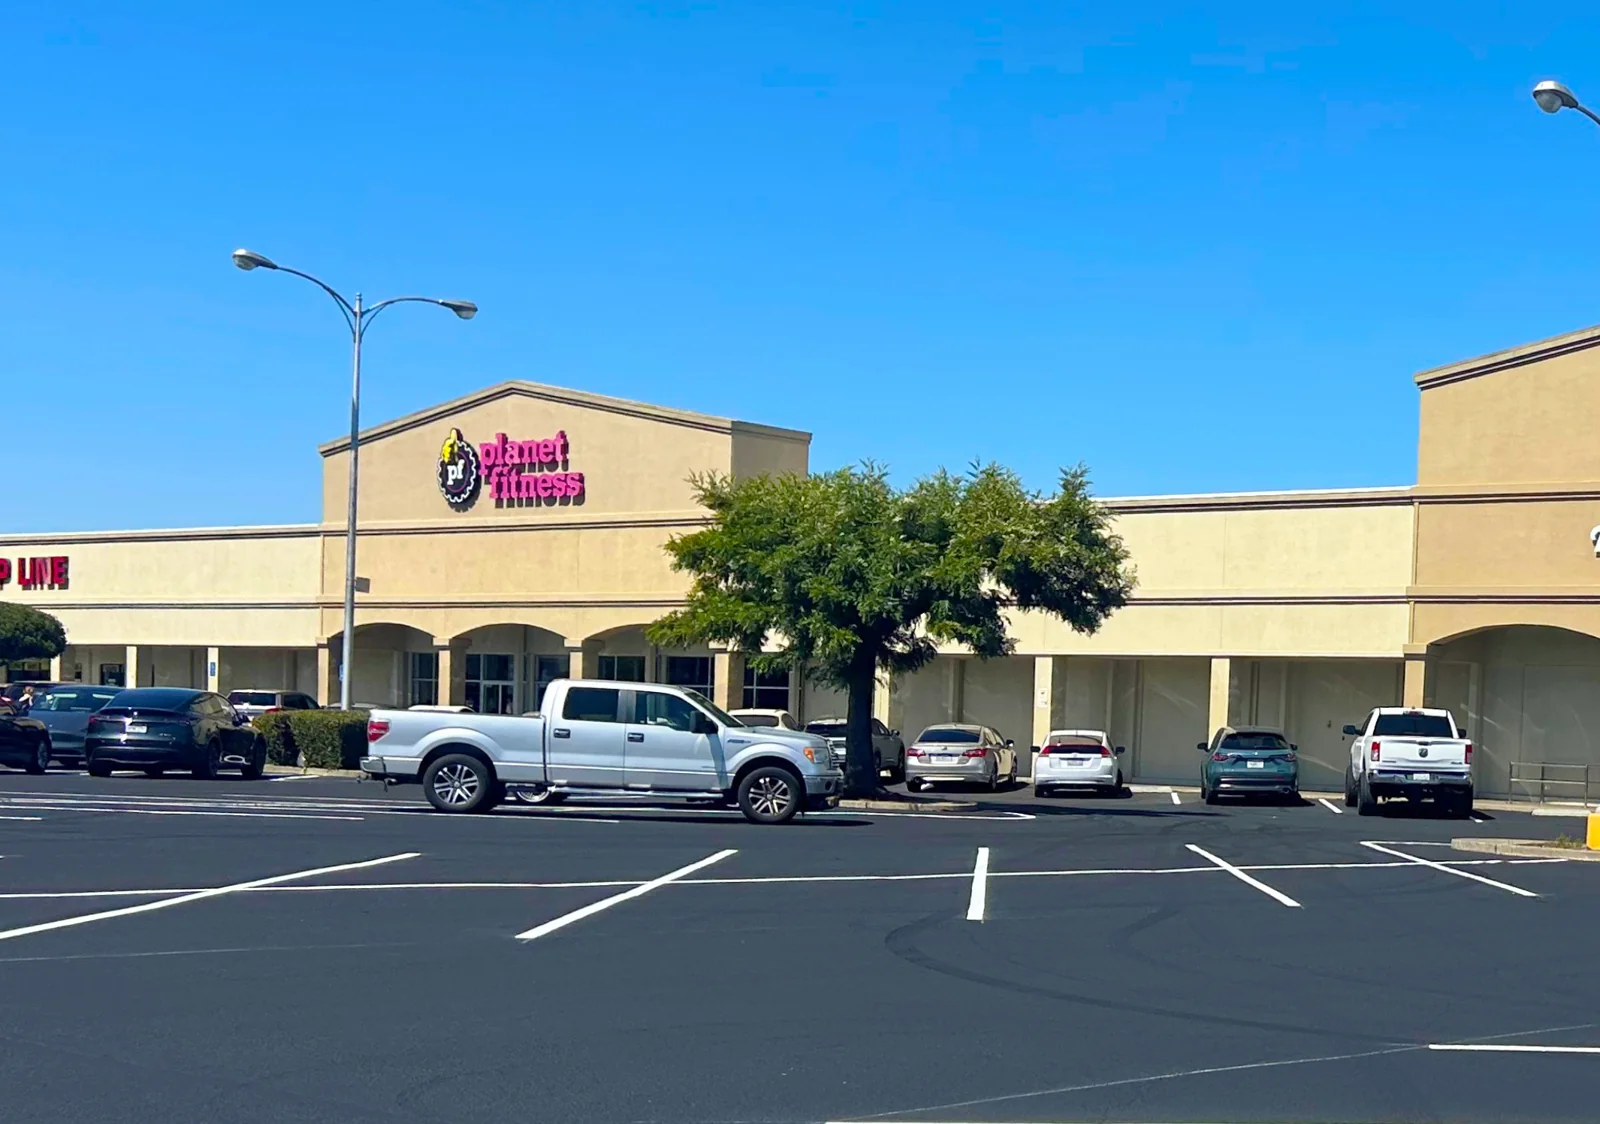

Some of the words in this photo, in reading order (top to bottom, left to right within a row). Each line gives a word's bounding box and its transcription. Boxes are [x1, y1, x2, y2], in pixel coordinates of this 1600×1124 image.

[479, 431, 568, 475] planet
[447, 459, 465, 485] pf
[489, 466, 584, 500] fitness
[18, 556, 68, 586] LINE
